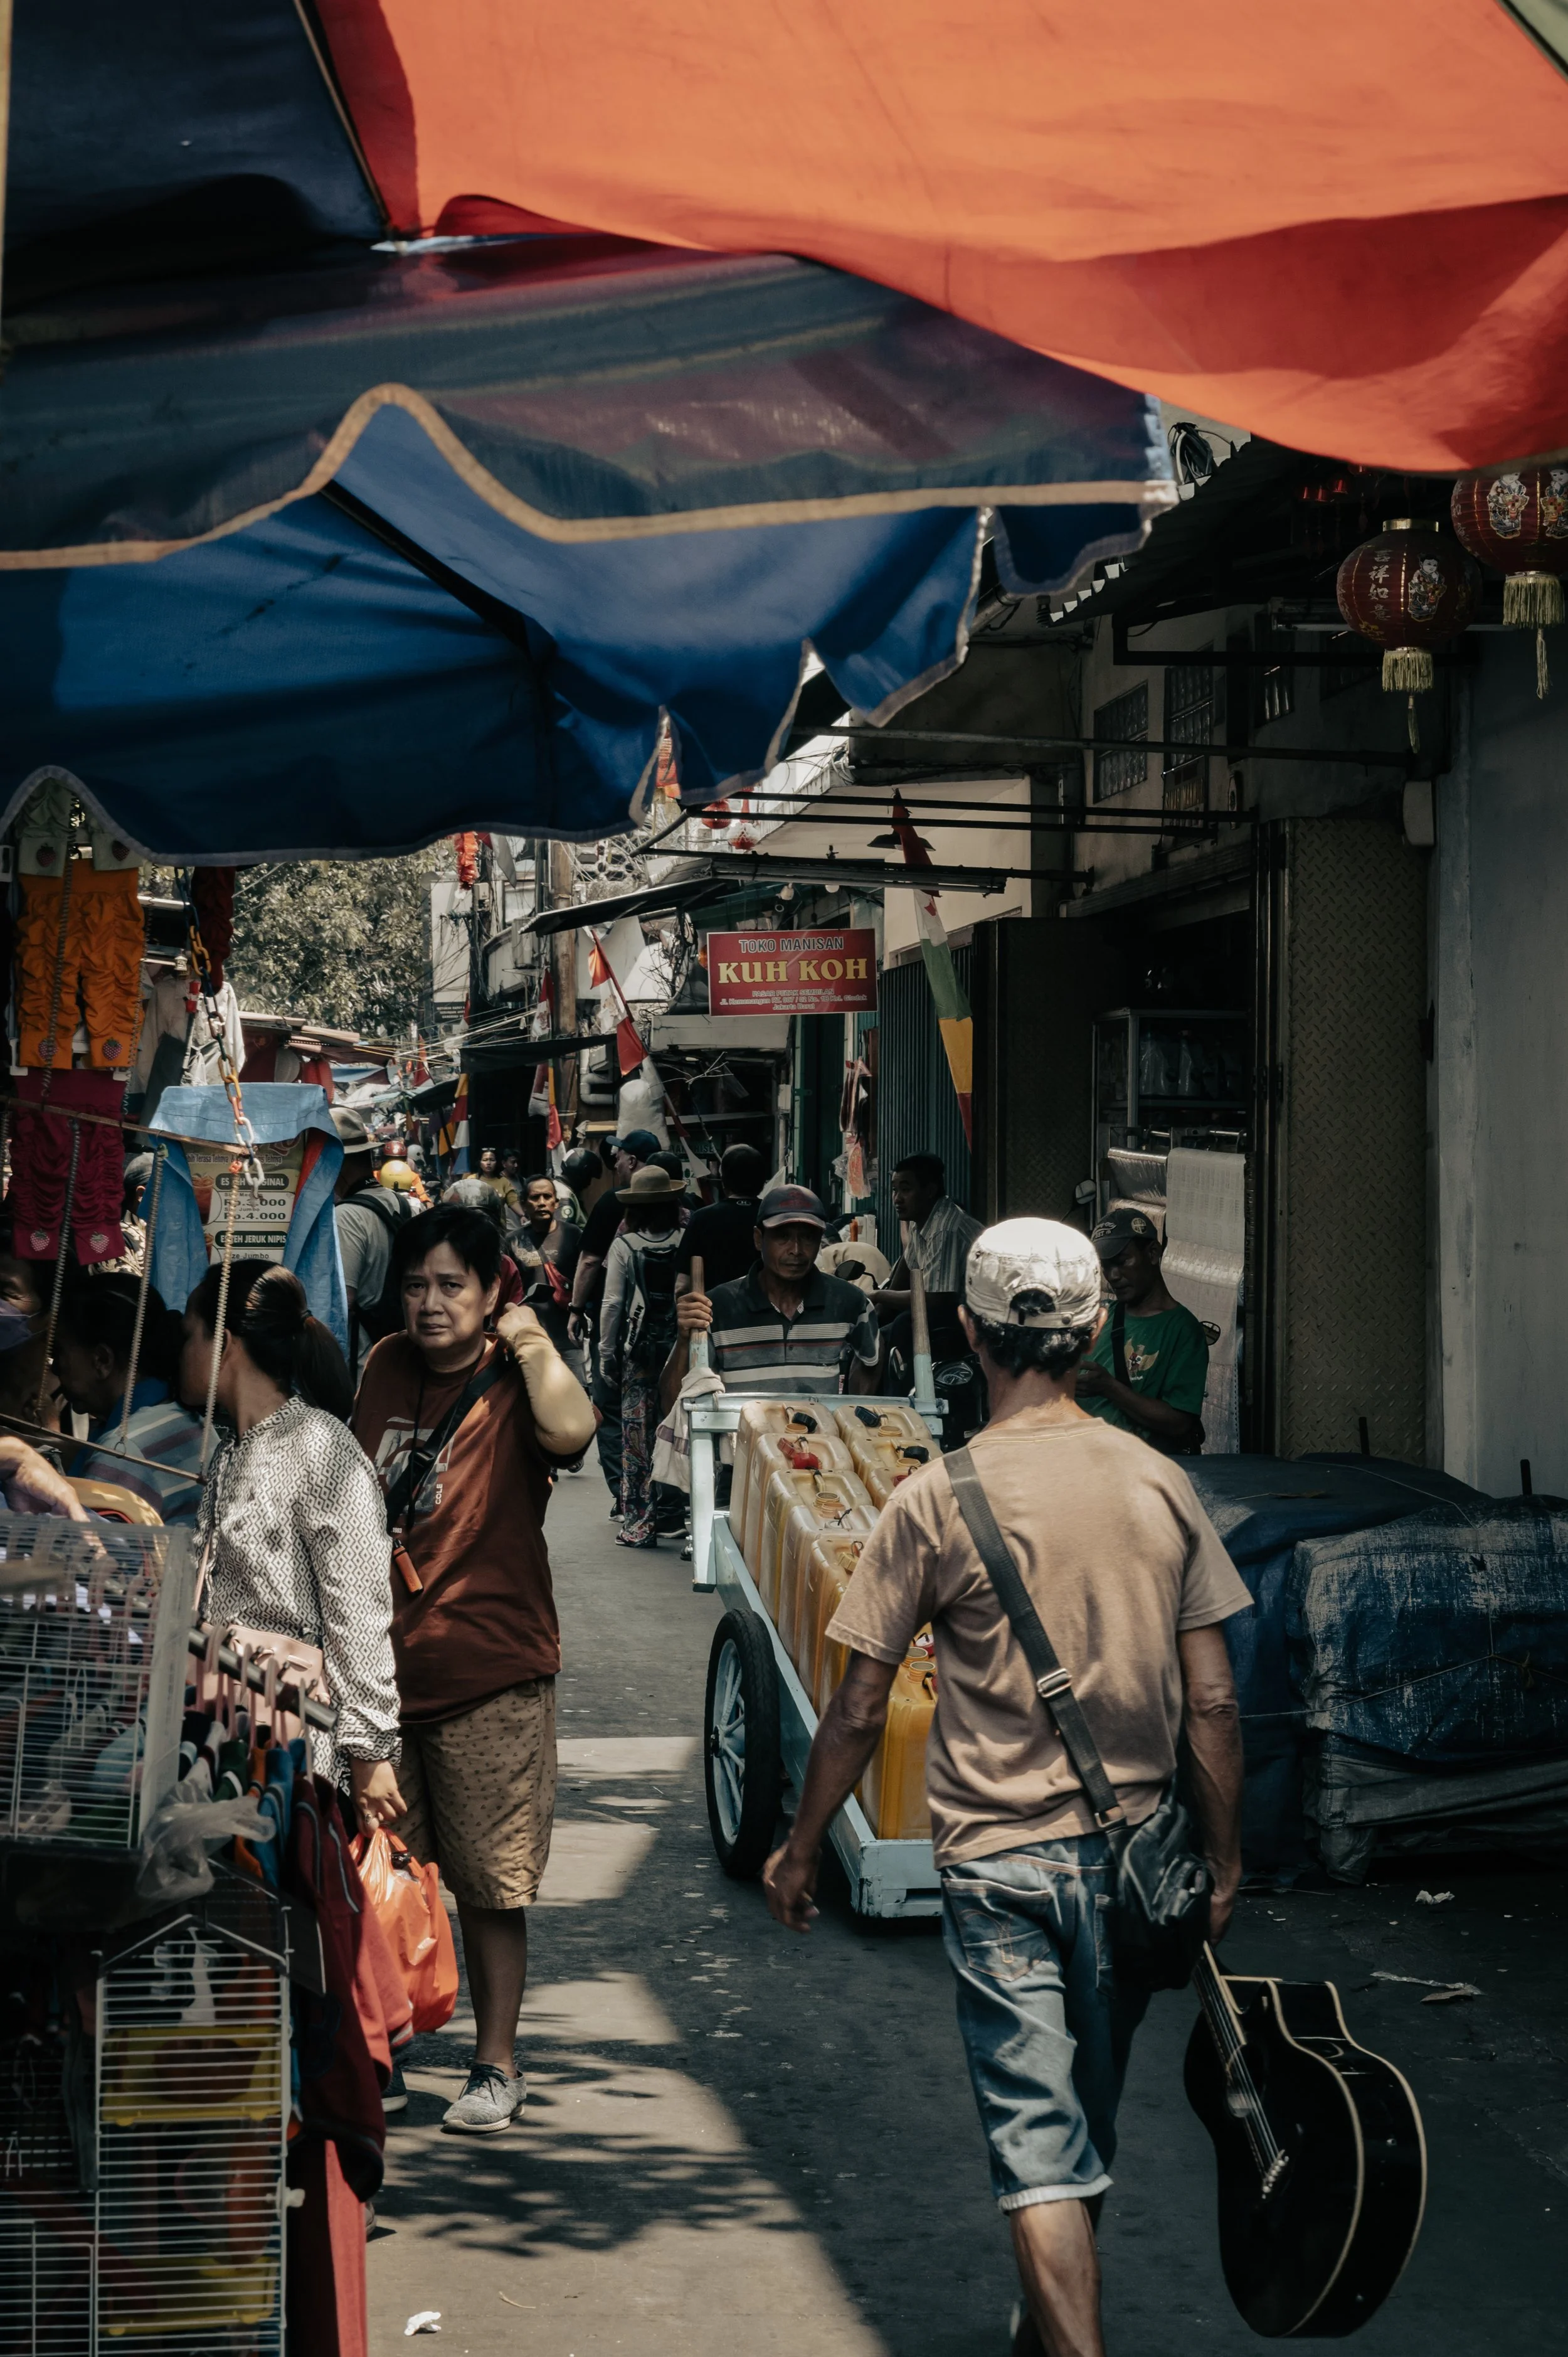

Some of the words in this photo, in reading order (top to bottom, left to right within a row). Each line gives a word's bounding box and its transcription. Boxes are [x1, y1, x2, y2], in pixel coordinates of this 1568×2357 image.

[739, 939, 776, 953] TOKO
[780, 936, 844, 952] MANISAN
[718, 960, 788, 984] KUH
[798, 958, 868, 981] KOH
[221, 1178, 230, 1186] ES
[435, 1484, 443, 1505] COLE
